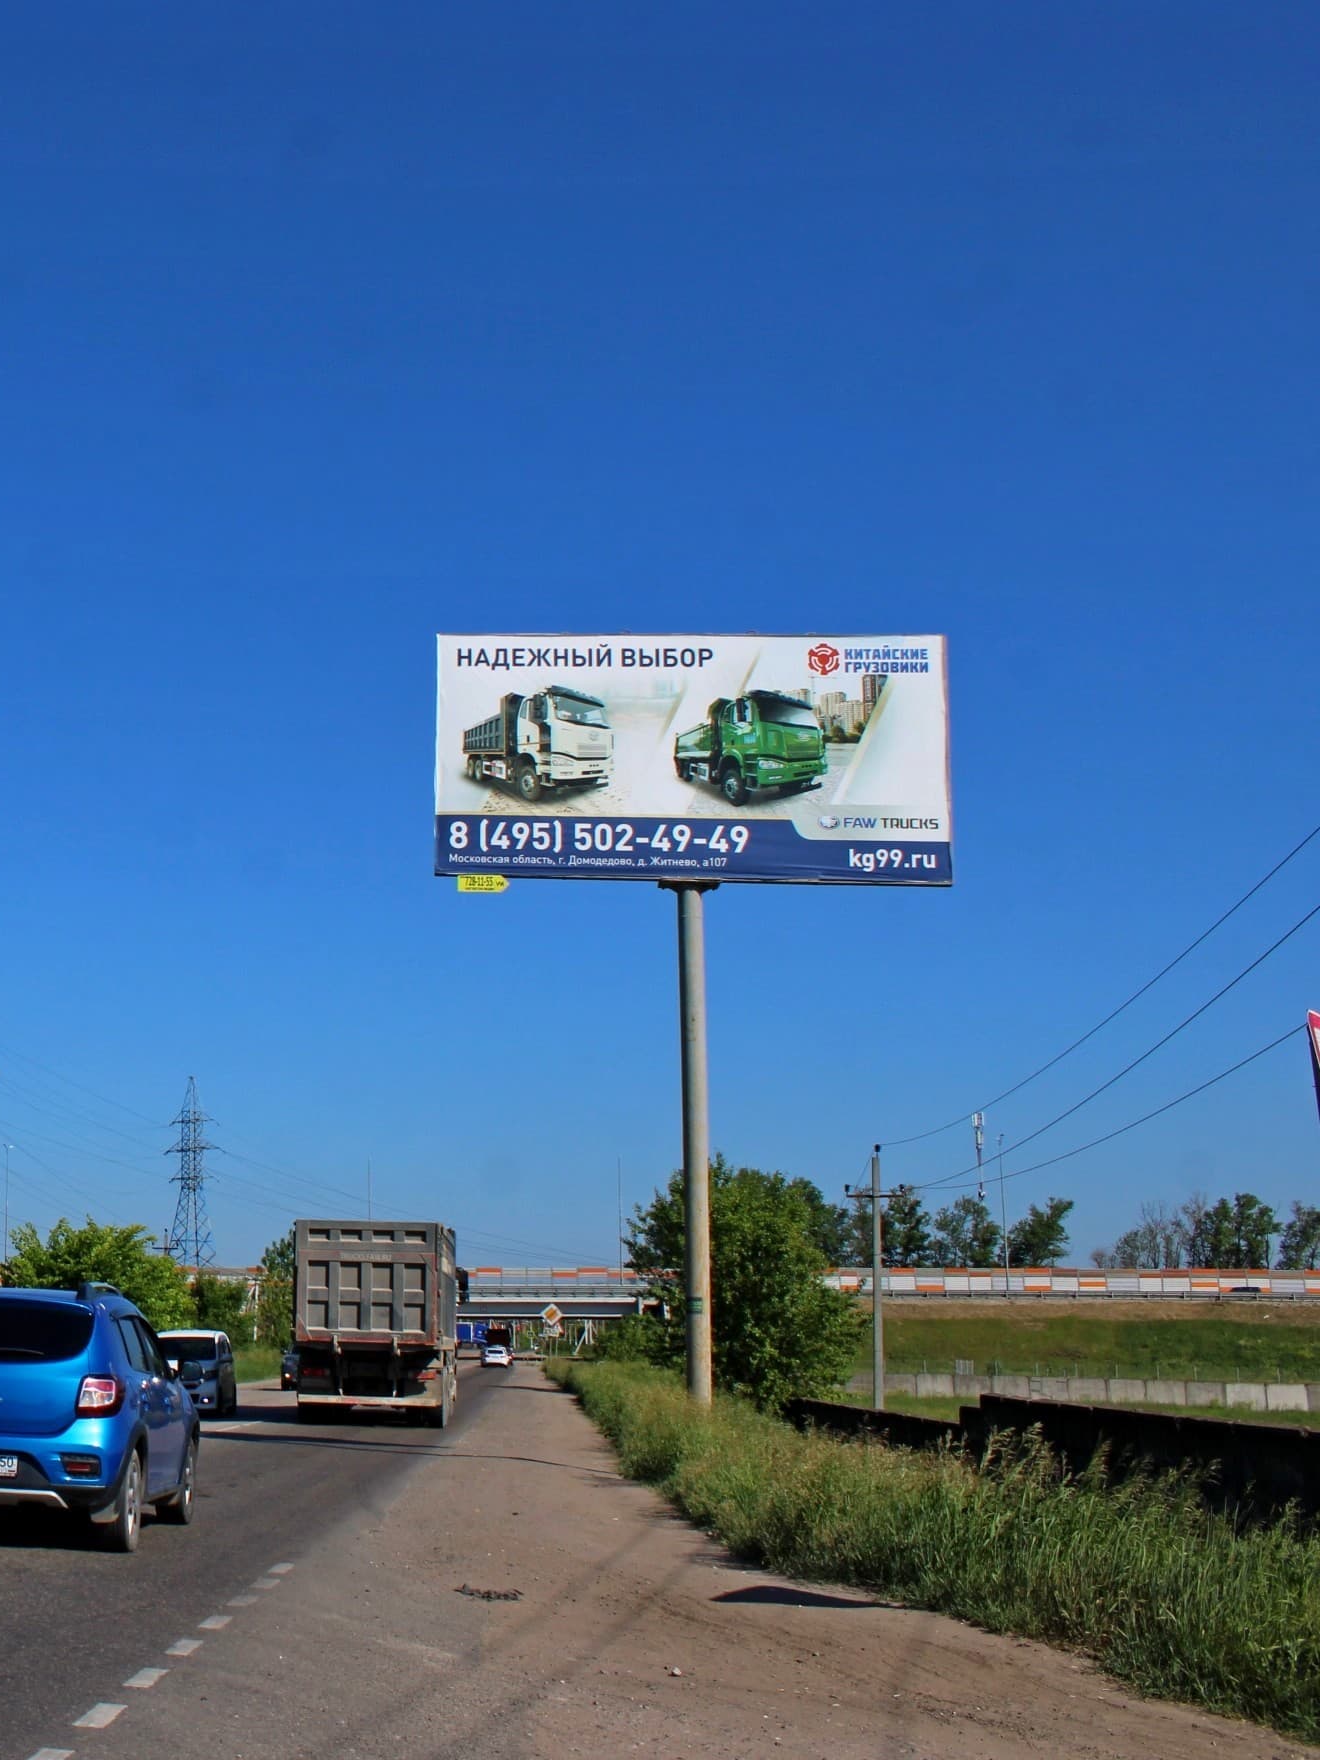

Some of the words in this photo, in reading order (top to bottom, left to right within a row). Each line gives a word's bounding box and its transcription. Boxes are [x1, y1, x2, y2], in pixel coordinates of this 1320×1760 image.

[456, 643, 613, 671] НАДЕЖНЫЙ
[620, 648, 714, 668] ВЫБОР
[844, 645, 929, 660] КИТАЙСКИЕ
[844, 661, 929, 674] ГРУЗОВИКИ
[843, 817, 877, 829] FAW
[880, 817, 940, 831] TRUCKS
[449, 821, 469, 849] 8
[479, 818, 563, 853] (495)
[573, 823, 750, 853] 502-49-49
[448, 853, 510, 863] Московская
[512, 855, 556, 865] область,
[558, 857, 566, 865] г.
[568, 855, 636, 867] Домодедово,
[650, 857, 700, 868] Житнево,
[848, 848, 937, 873] kg99.ru
